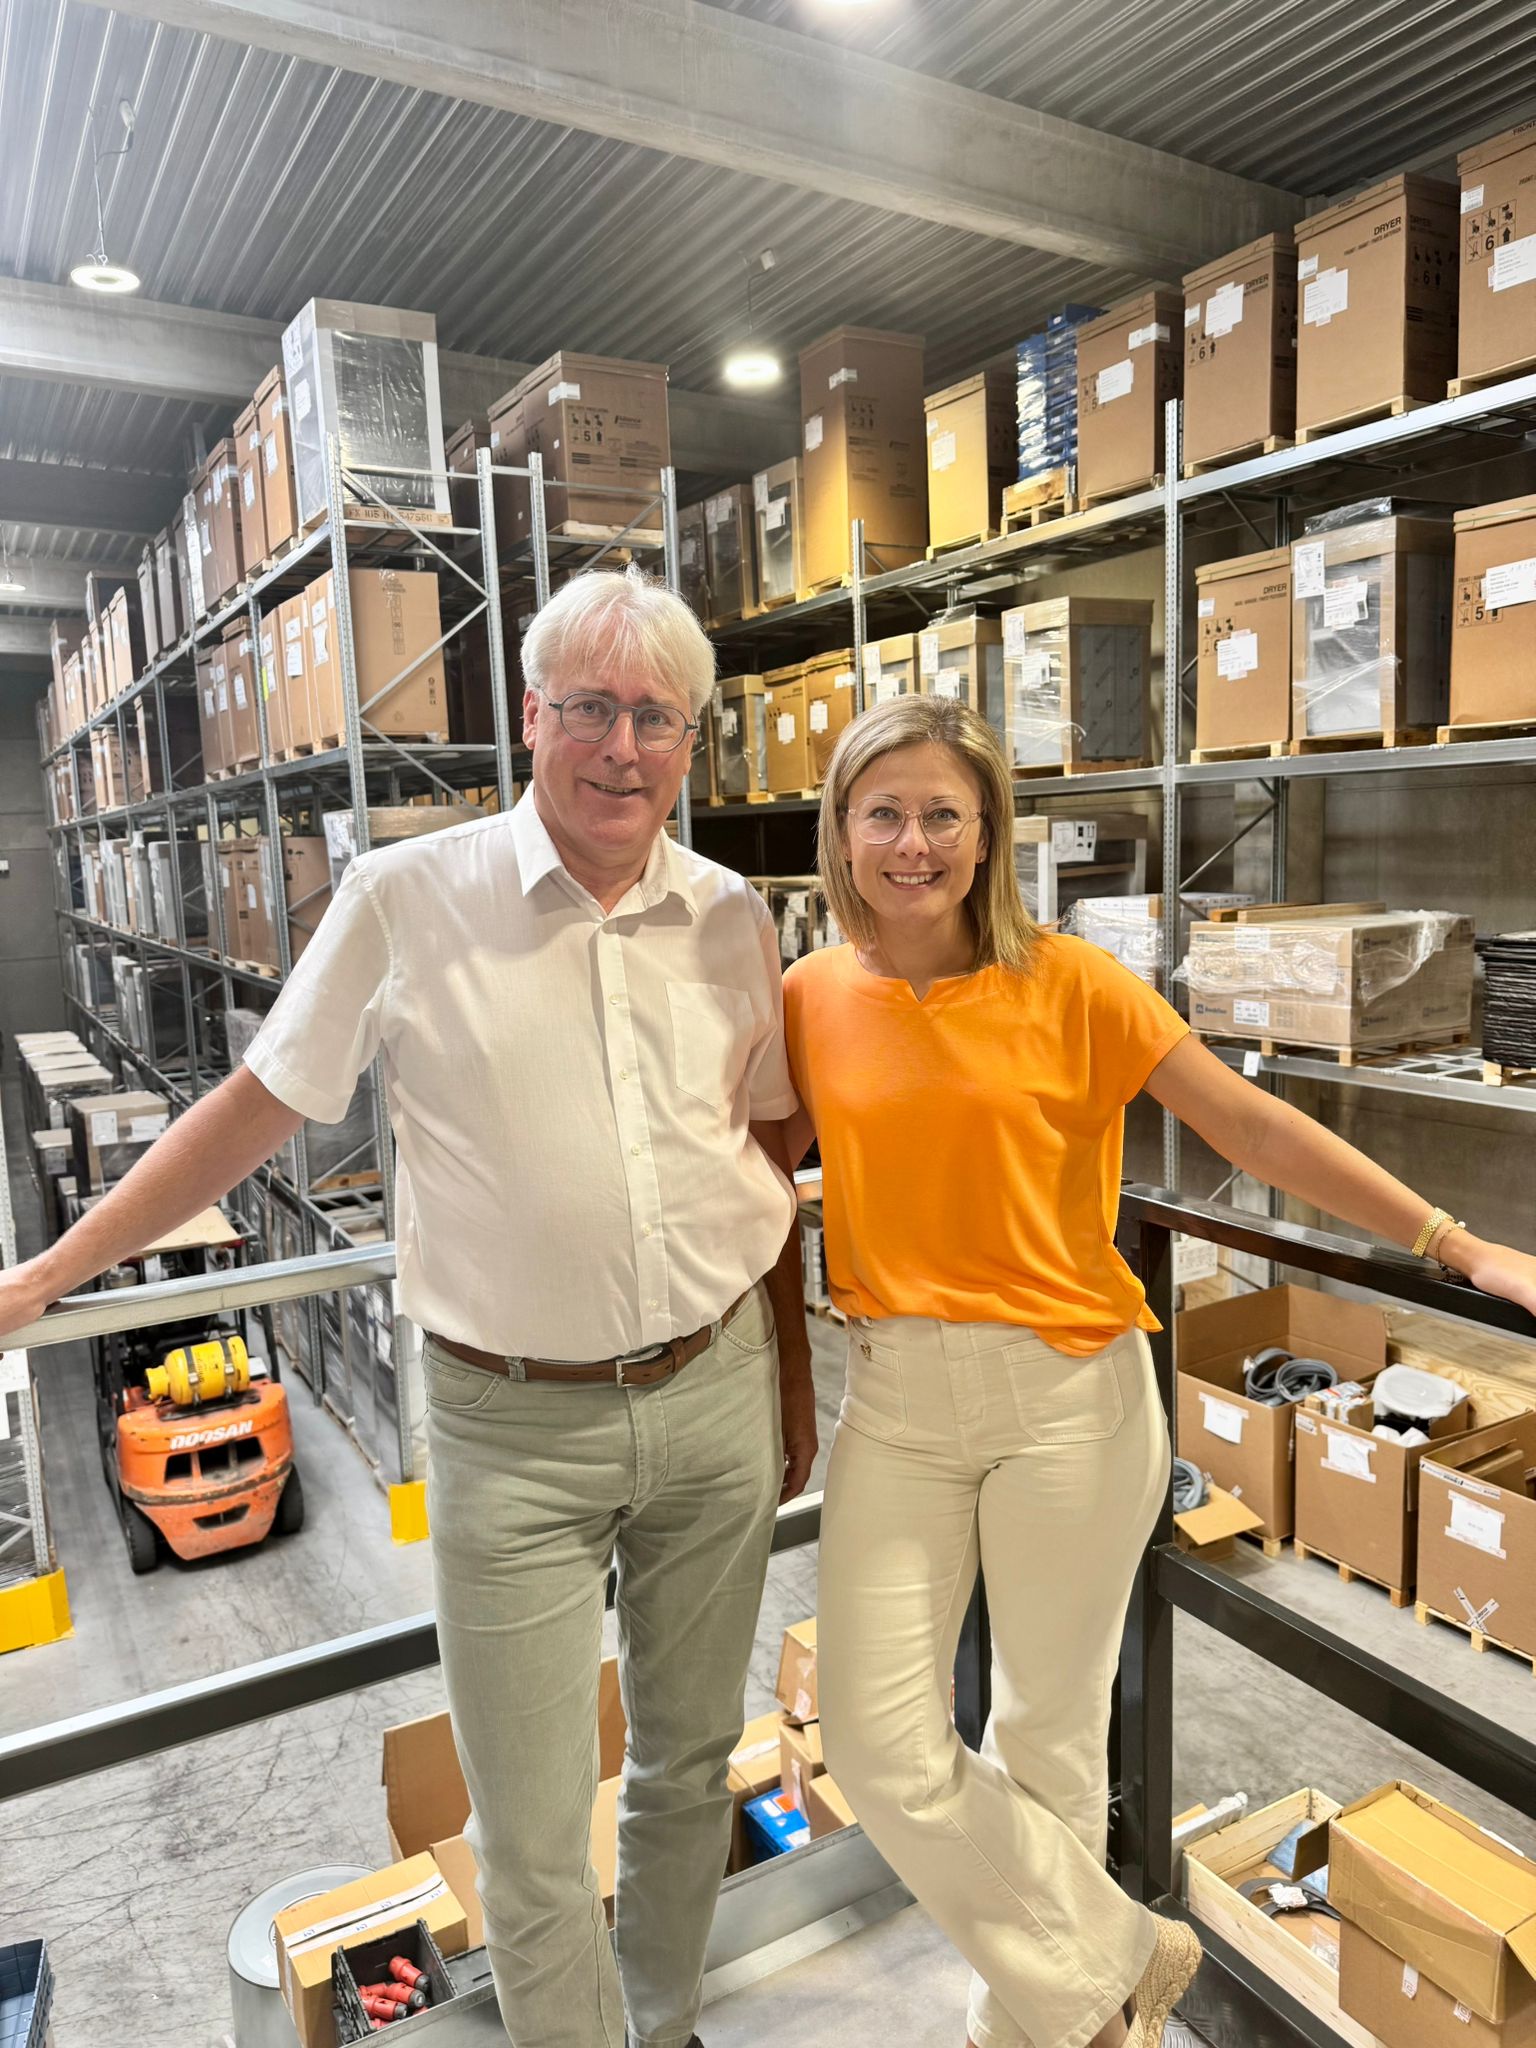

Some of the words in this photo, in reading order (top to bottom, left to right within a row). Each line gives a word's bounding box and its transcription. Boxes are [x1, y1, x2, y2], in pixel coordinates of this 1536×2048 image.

[1373, 216, 1402, 236] DRYER
[1485, 234, 1495, 251] 6
[1245, 273, 1269, 290] DRYER
[1198, 346, 1206, 360] 6
[583, 430, 592, 442] 5
[1263, 583, 1288, 595] DRYER
[1475, 605, 1485, 621] 5
[169, 1419, 254, 1451] DOOSAN
